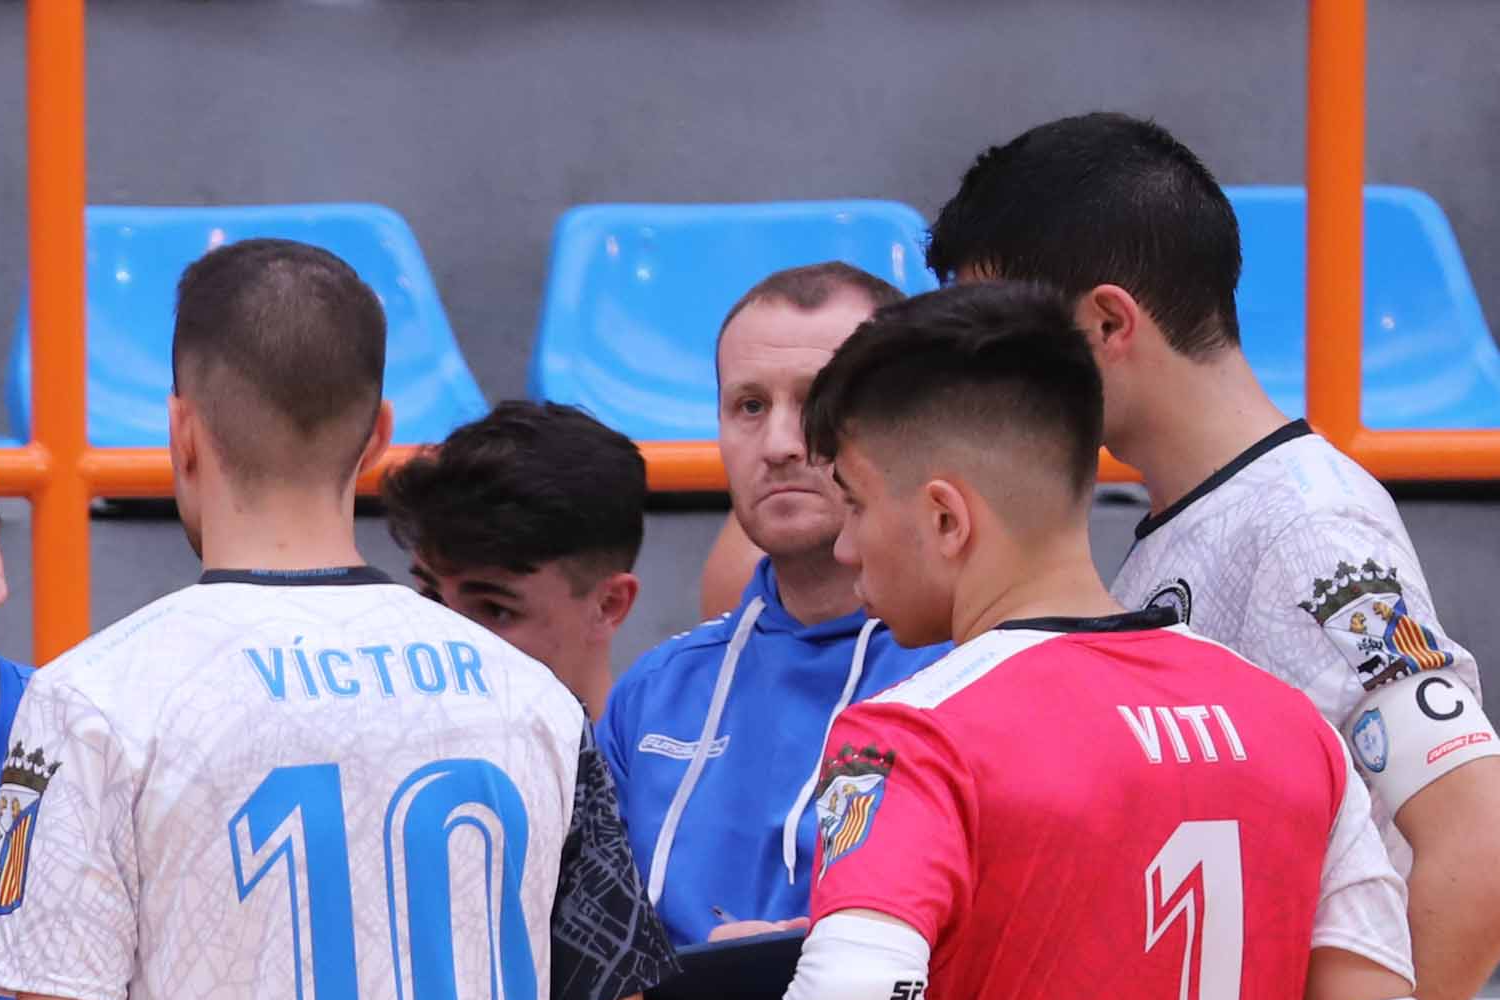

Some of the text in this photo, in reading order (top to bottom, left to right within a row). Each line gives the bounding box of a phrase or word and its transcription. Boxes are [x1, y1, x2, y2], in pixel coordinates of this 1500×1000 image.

[242, 635, 491, 701] VÍCTOR
[1416, 677, 1464, 721] C
[1116, 705, 1248, 764] VITI
